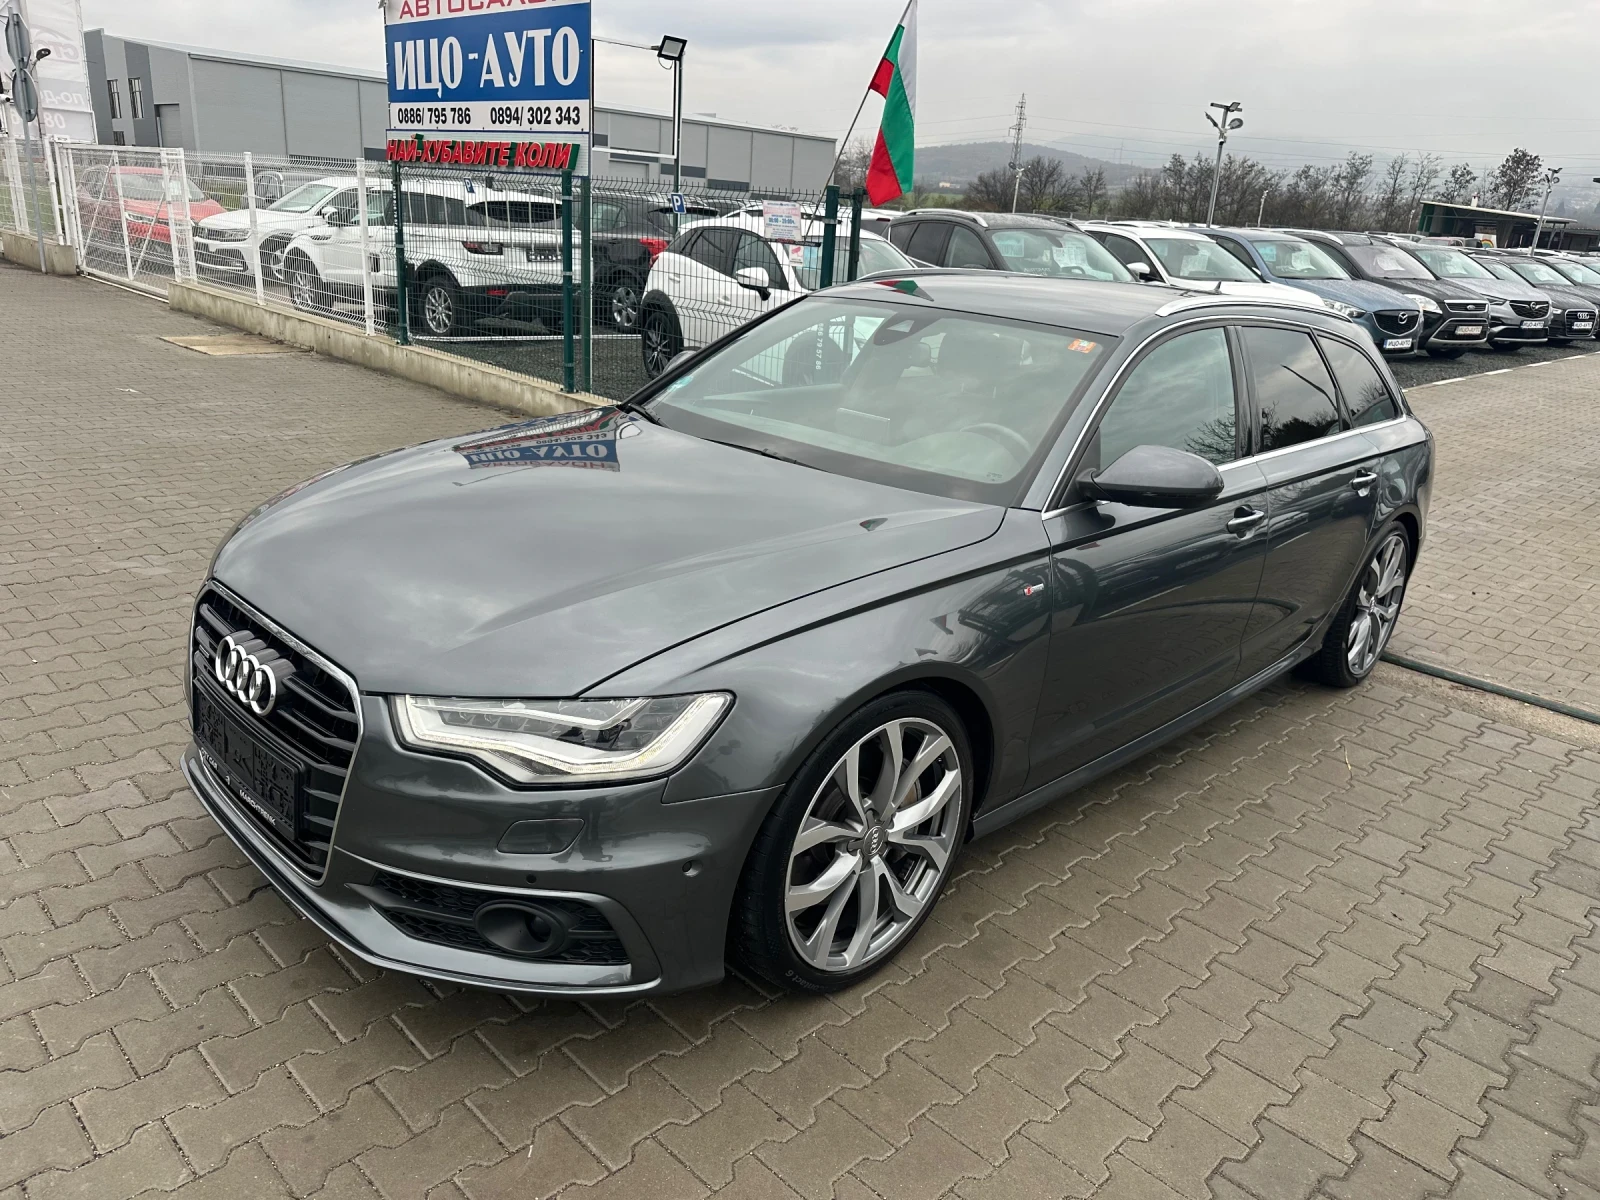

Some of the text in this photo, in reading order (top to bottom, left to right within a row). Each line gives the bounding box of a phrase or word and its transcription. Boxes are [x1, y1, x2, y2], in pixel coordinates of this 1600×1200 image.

[399, 0, 556, 19] АВТОС
[397, 107, 471, 125] 0886/ 795 786
[490, 106, 580, 126] 0894/ 302 343
[513, 142, 573, 169] КОЛИ
[673, 195, 681, 211] P
